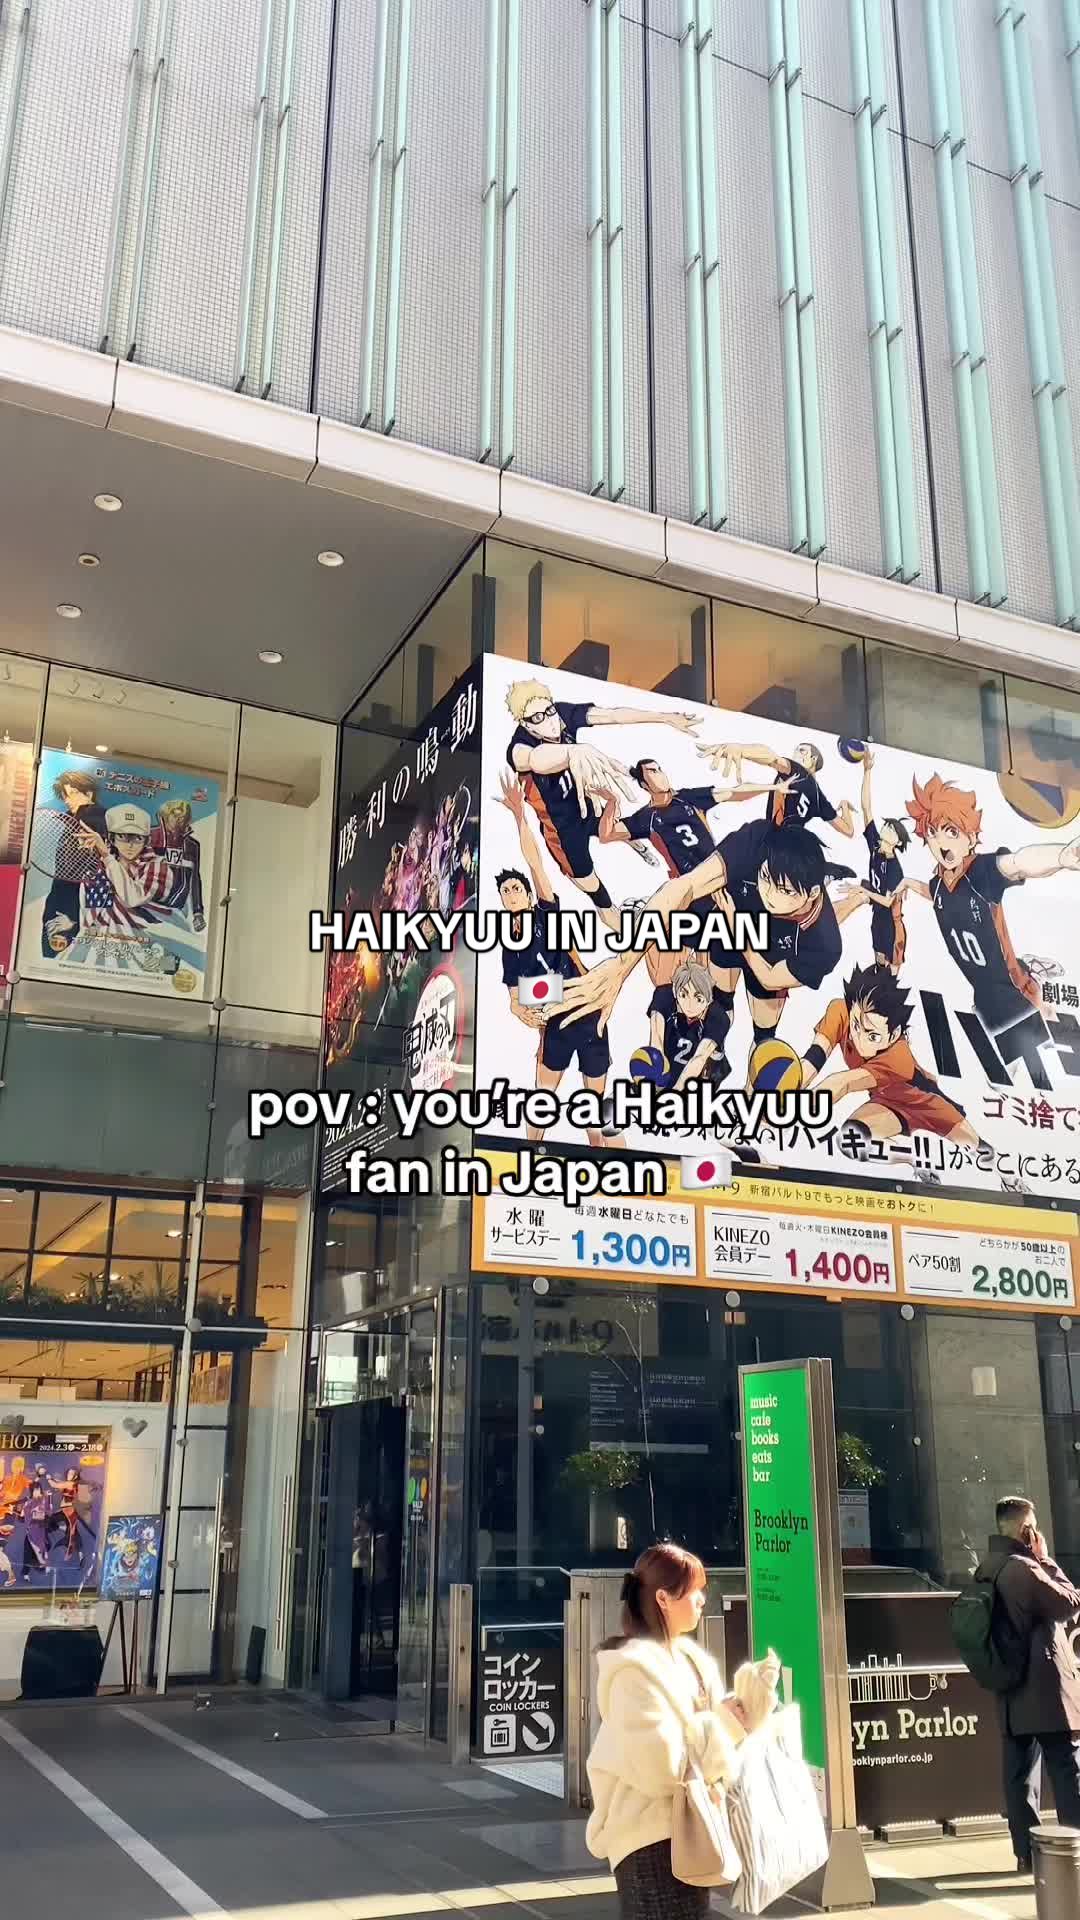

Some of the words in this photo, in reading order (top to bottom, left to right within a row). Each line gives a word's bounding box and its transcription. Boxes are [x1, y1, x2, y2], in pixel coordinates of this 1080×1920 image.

[337, 683, 478, 872] 勝利の鳴動
[796, 792, 811, 818] 5
[675, 824, 699, 847] 3
[950, 927, 988, 967] 10
[1042, 981, 1080, 1008] 劇場
[674, 1039, 694, 1063] 2
[982, 1094, 1080, 1132] ゴミ捨て
[490, 1226, 561, 1247] サービスデー
[714, 1225, 770, 1246] KINEZO
[571, 1229, 690, 1267] 1,300円
[714, 1244, 771, 1264] 会員デー
[785, 1248, 890, 1285] 1,400円
[908, 1254, 961, 1273] ペア50割
[971, 1264, 1068, 1299] 2,800円
[750, 1393, 778, 1409] music
[751, 1429, 780, 1445] books
[752, 1450, 772, 1463] eats
[752, 1466, 770, 1481] bar
[754, 1508, 808, 1535] Brooklyn
[755, 1532, 791, 1552] Parlor
[484, 1653, 541, 1677] コイン
[484, 1676, 556, 1701] ロッカー
[489, 1703, 512, 1712] COIN
[513, 1701, 550, 1711] LOCKERS
[850, 1718, 890, 1750] yn
[897, 1706, 978, 1740] Parlor
